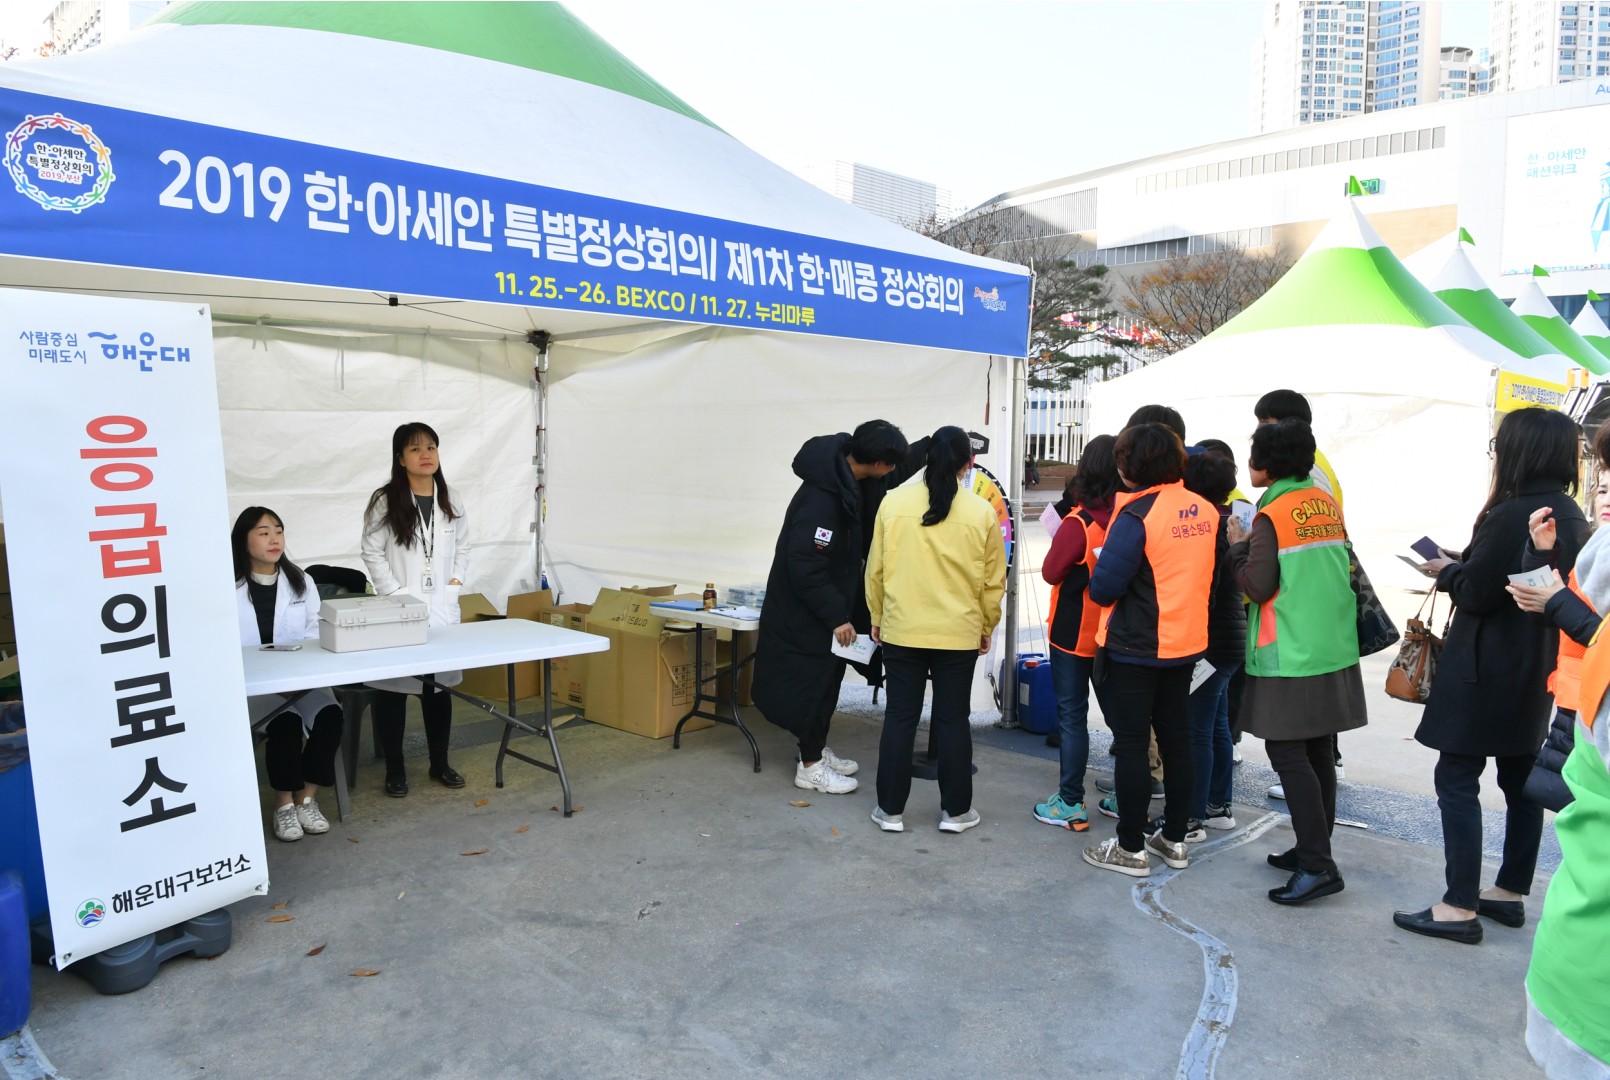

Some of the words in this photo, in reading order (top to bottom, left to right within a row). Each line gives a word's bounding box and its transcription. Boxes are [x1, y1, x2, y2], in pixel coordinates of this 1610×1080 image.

[36, 143, 84, 161] 한·아세안
[29, 155, 93, 175] 특별정상회의
[1526, 163, 1578, 179] 패션위크
[66, 173, 81, 183] 부산
[158, 149, 291, 223] 2019
[303, 170, 494, 252] 한·아세안
[724, 241, 793, 291] 제1차
[797, 252, 878, 302] 한·메콩
[882, 267, 964, 315] 정상회의
[495, 271, 524, 295] 11.
[616, 285, 685, 311] BEXCO
[701, 296, 722, 315] 11.
[726, 298, 751, 319] 27.
[755, 302, 815, 326] 누리마루
[19, 330, 78, 348] 사람중심
[29, 348, 87, 365] 미래도시
[87, 331, 191, 372] 해운대
[1171, 520, 1212, 539] 의용소방대
[80, 415, 196, 833] 응급의료소
[111, 853, 251, 915] 해운대구보건소
